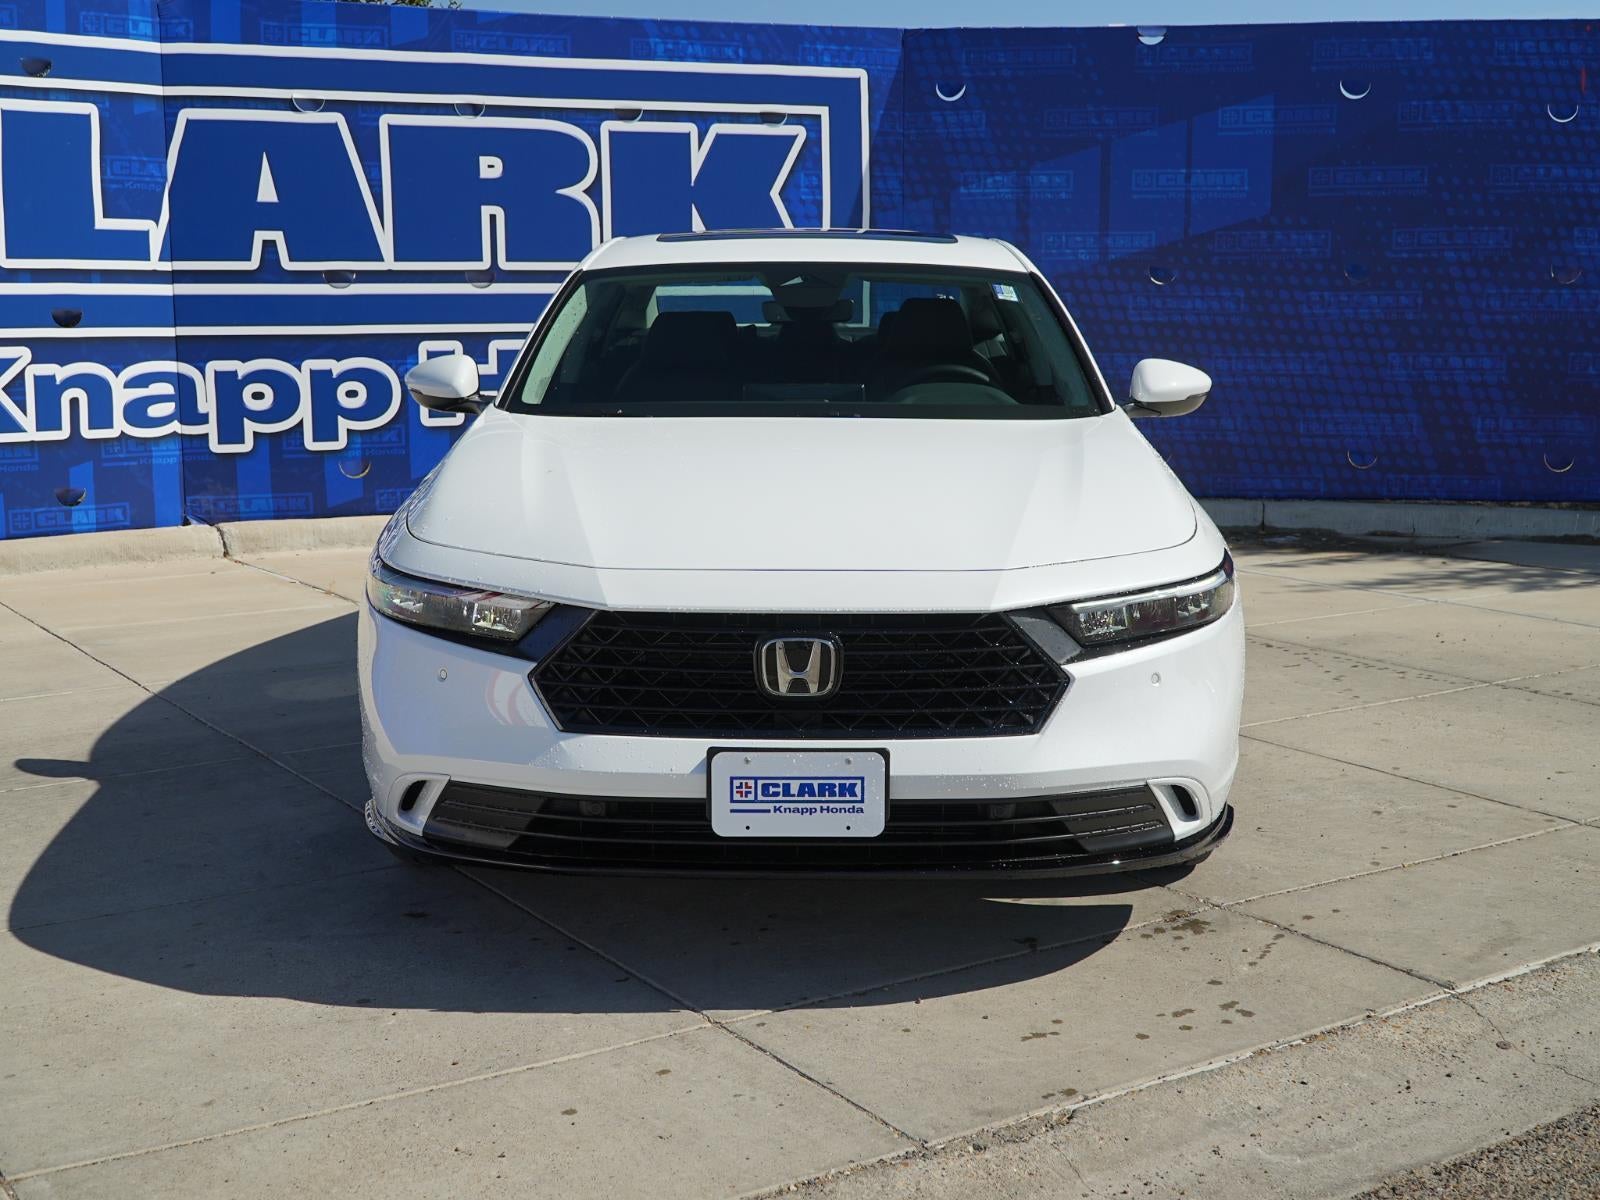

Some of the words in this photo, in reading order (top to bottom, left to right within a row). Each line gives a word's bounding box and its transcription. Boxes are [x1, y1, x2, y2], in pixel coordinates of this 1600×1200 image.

[760, 782, 859, 798] CLARK
[773, 805, 818, 816] Knapp
[819, 805, 865, 814] Honda
